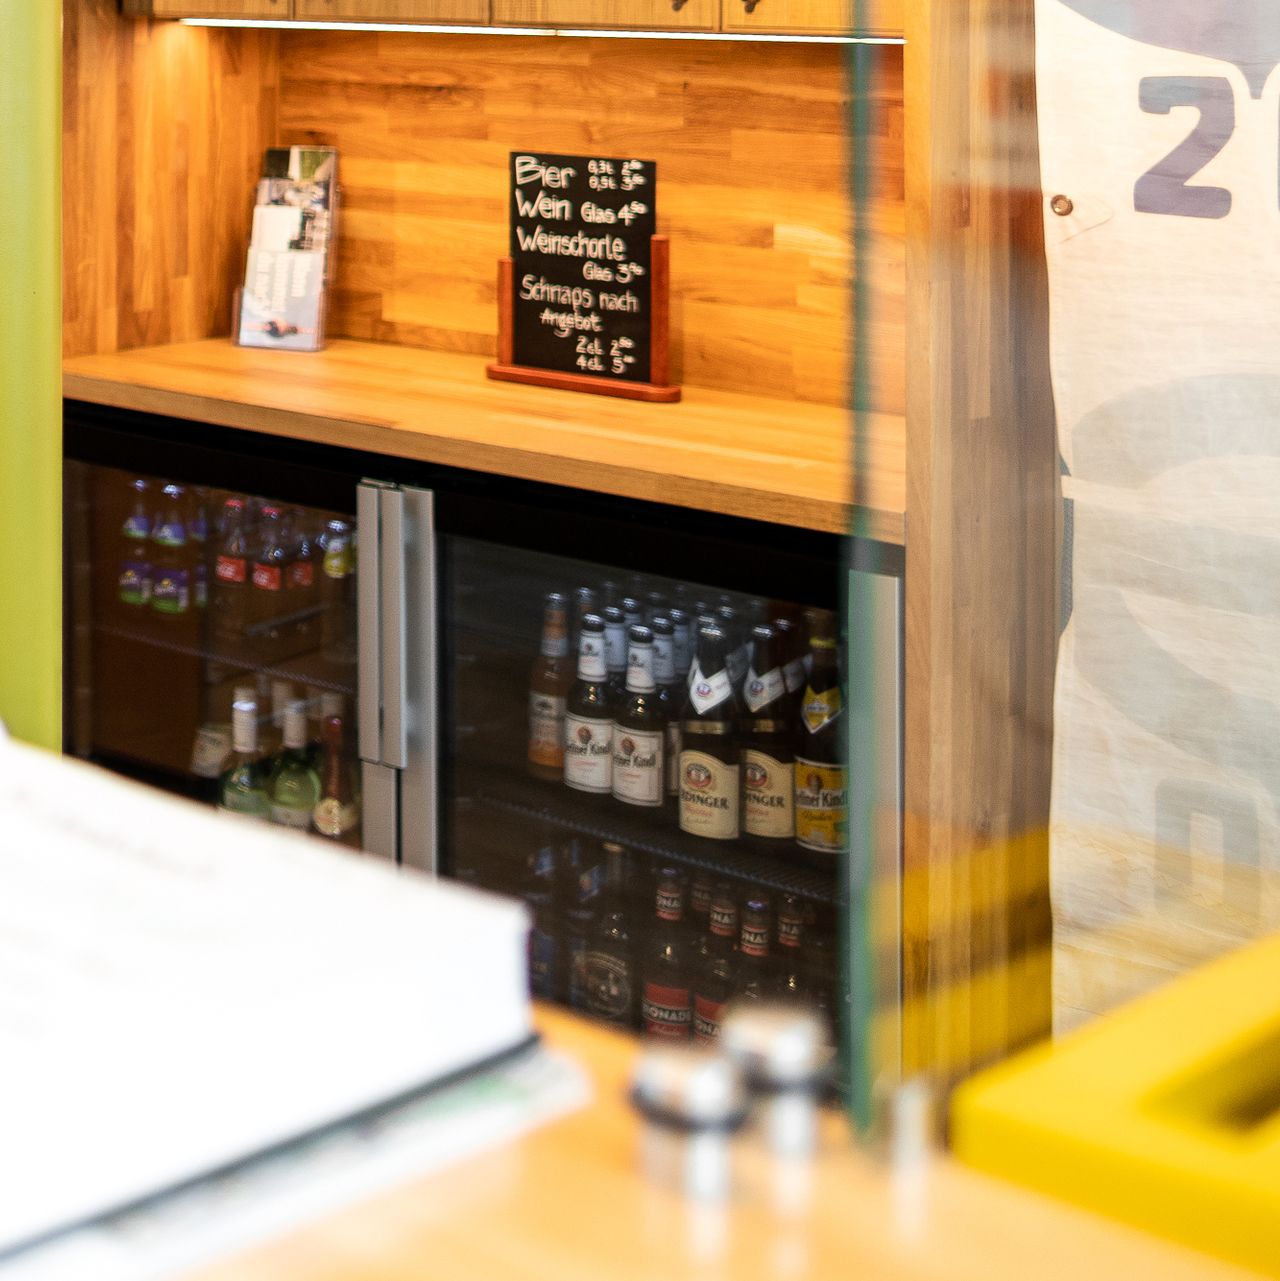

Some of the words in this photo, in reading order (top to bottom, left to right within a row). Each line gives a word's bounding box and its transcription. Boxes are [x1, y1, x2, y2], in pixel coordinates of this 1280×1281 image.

[1133, 75, 1280, 220] 2
[515, 155, 577, 189] Bier
[515, 188, 573, 221] Wein
[580, 201, 617, 225] Glas
[516, 224, 627, 261] Weinschorle
[582, 260, 614, 282] Glas
[519, 273, 594, 312] Schnaps
[598, 288, 639, 313] nach
[539, 306, 604, 338] Angebot
[681, 790, 729, 810] RDINGER
